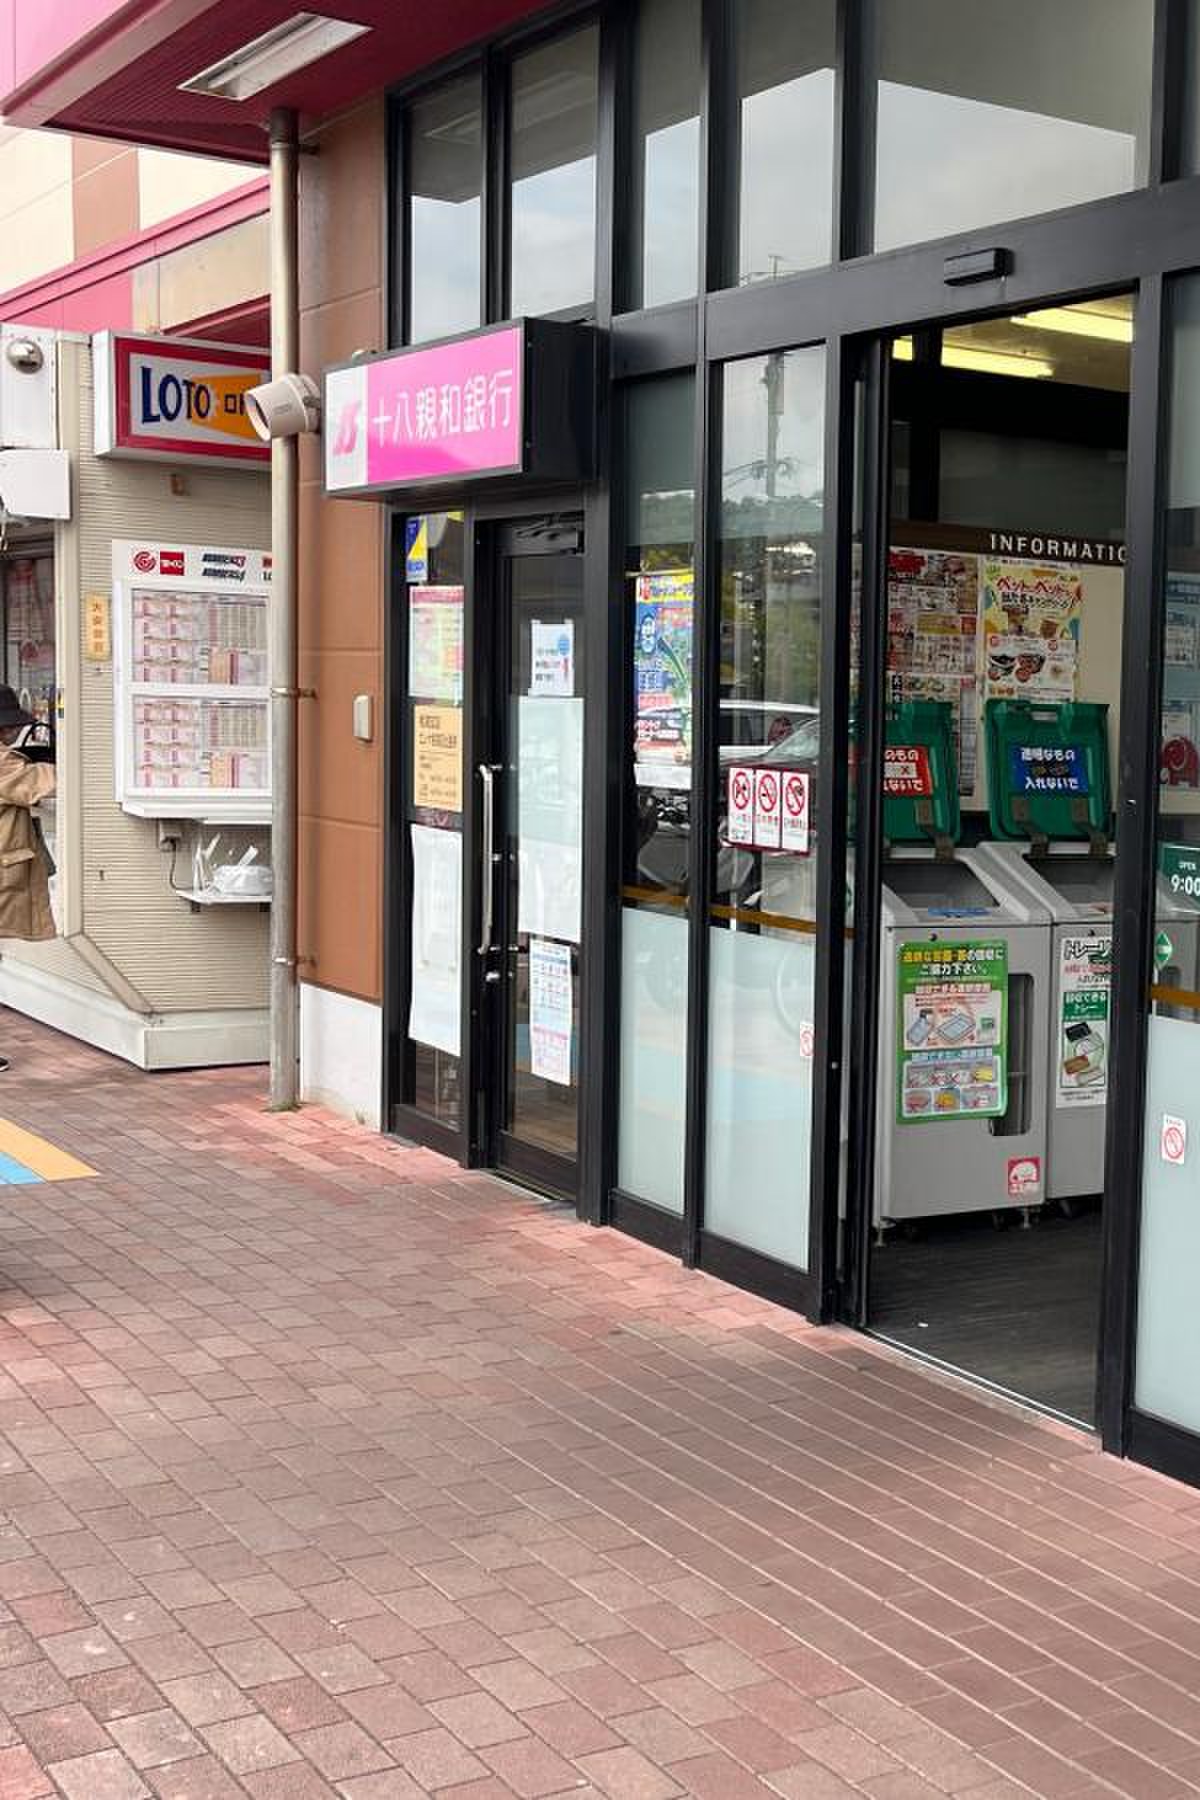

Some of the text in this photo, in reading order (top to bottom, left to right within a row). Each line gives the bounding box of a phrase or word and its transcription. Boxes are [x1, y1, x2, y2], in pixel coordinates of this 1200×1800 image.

[140, 365, 211, 425] LOTO
[371, 368, 513, 449] 十八親和銀行
